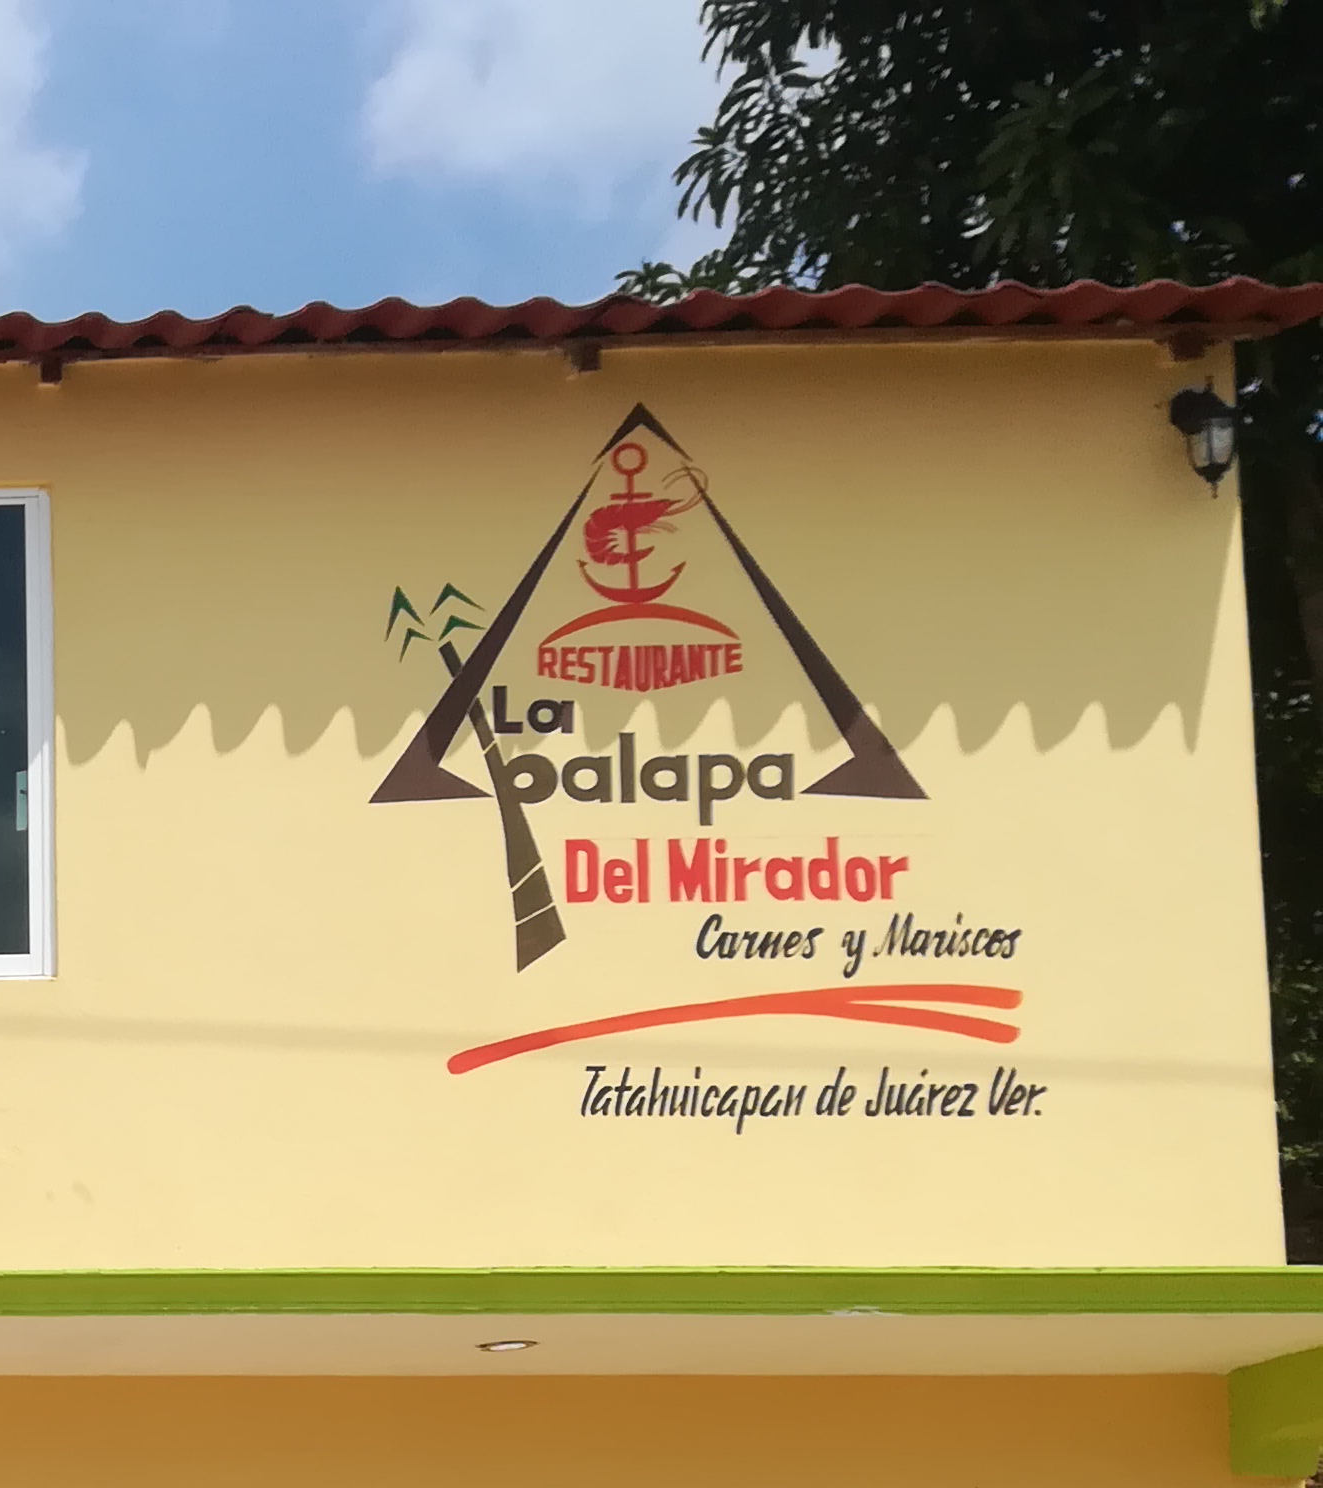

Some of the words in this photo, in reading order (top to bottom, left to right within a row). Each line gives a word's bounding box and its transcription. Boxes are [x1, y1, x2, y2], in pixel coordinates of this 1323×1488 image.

[537, 641, 744, 692] RESTAURANTE
[492, 685, 574, 734] La
[490, 732, 795, 826] palapa
[564, 838, 650, 903] Del
[667, 836, 909, 903] Mirador
[695, 914, 824, 960] Carnes
[841, 926, 867, 979] y
[872, 912, 1023, 960] Mariscos
[579, 1065, 804, 1135] Tatahuicapan
[815, 1066, 855, 1117] de
[865, 1067, 977, 1119] Juárez
[985, 1067, 1047, 1118] Ver.
